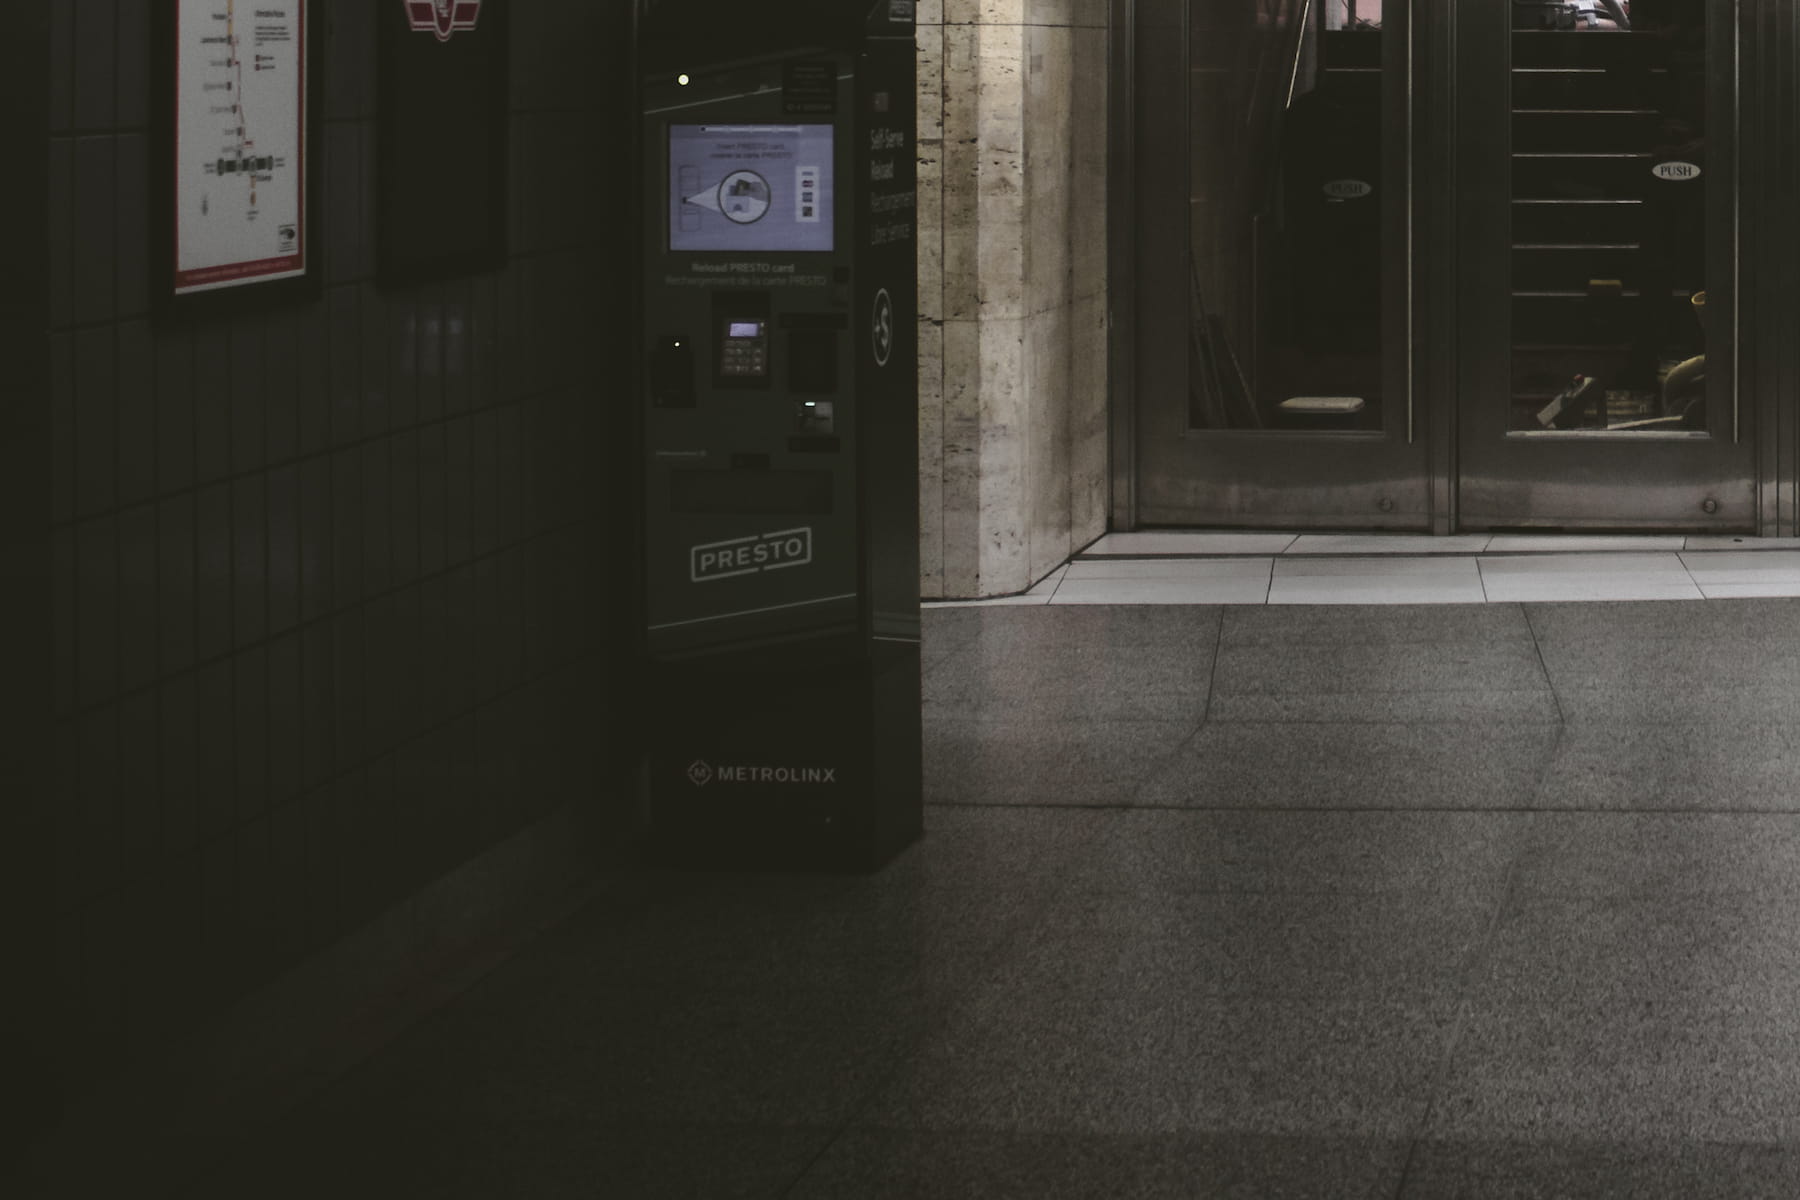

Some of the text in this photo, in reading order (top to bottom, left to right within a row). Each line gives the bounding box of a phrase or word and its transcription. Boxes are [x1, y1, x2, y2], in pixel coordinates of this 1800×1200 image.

[1661, 165, 1692, 177] PUSH
[691, 263, 795, 273] Reload PRESTO card
[700, 537, 803, 572] PRESTO
[717, 766, 836, 783] METROLINX
